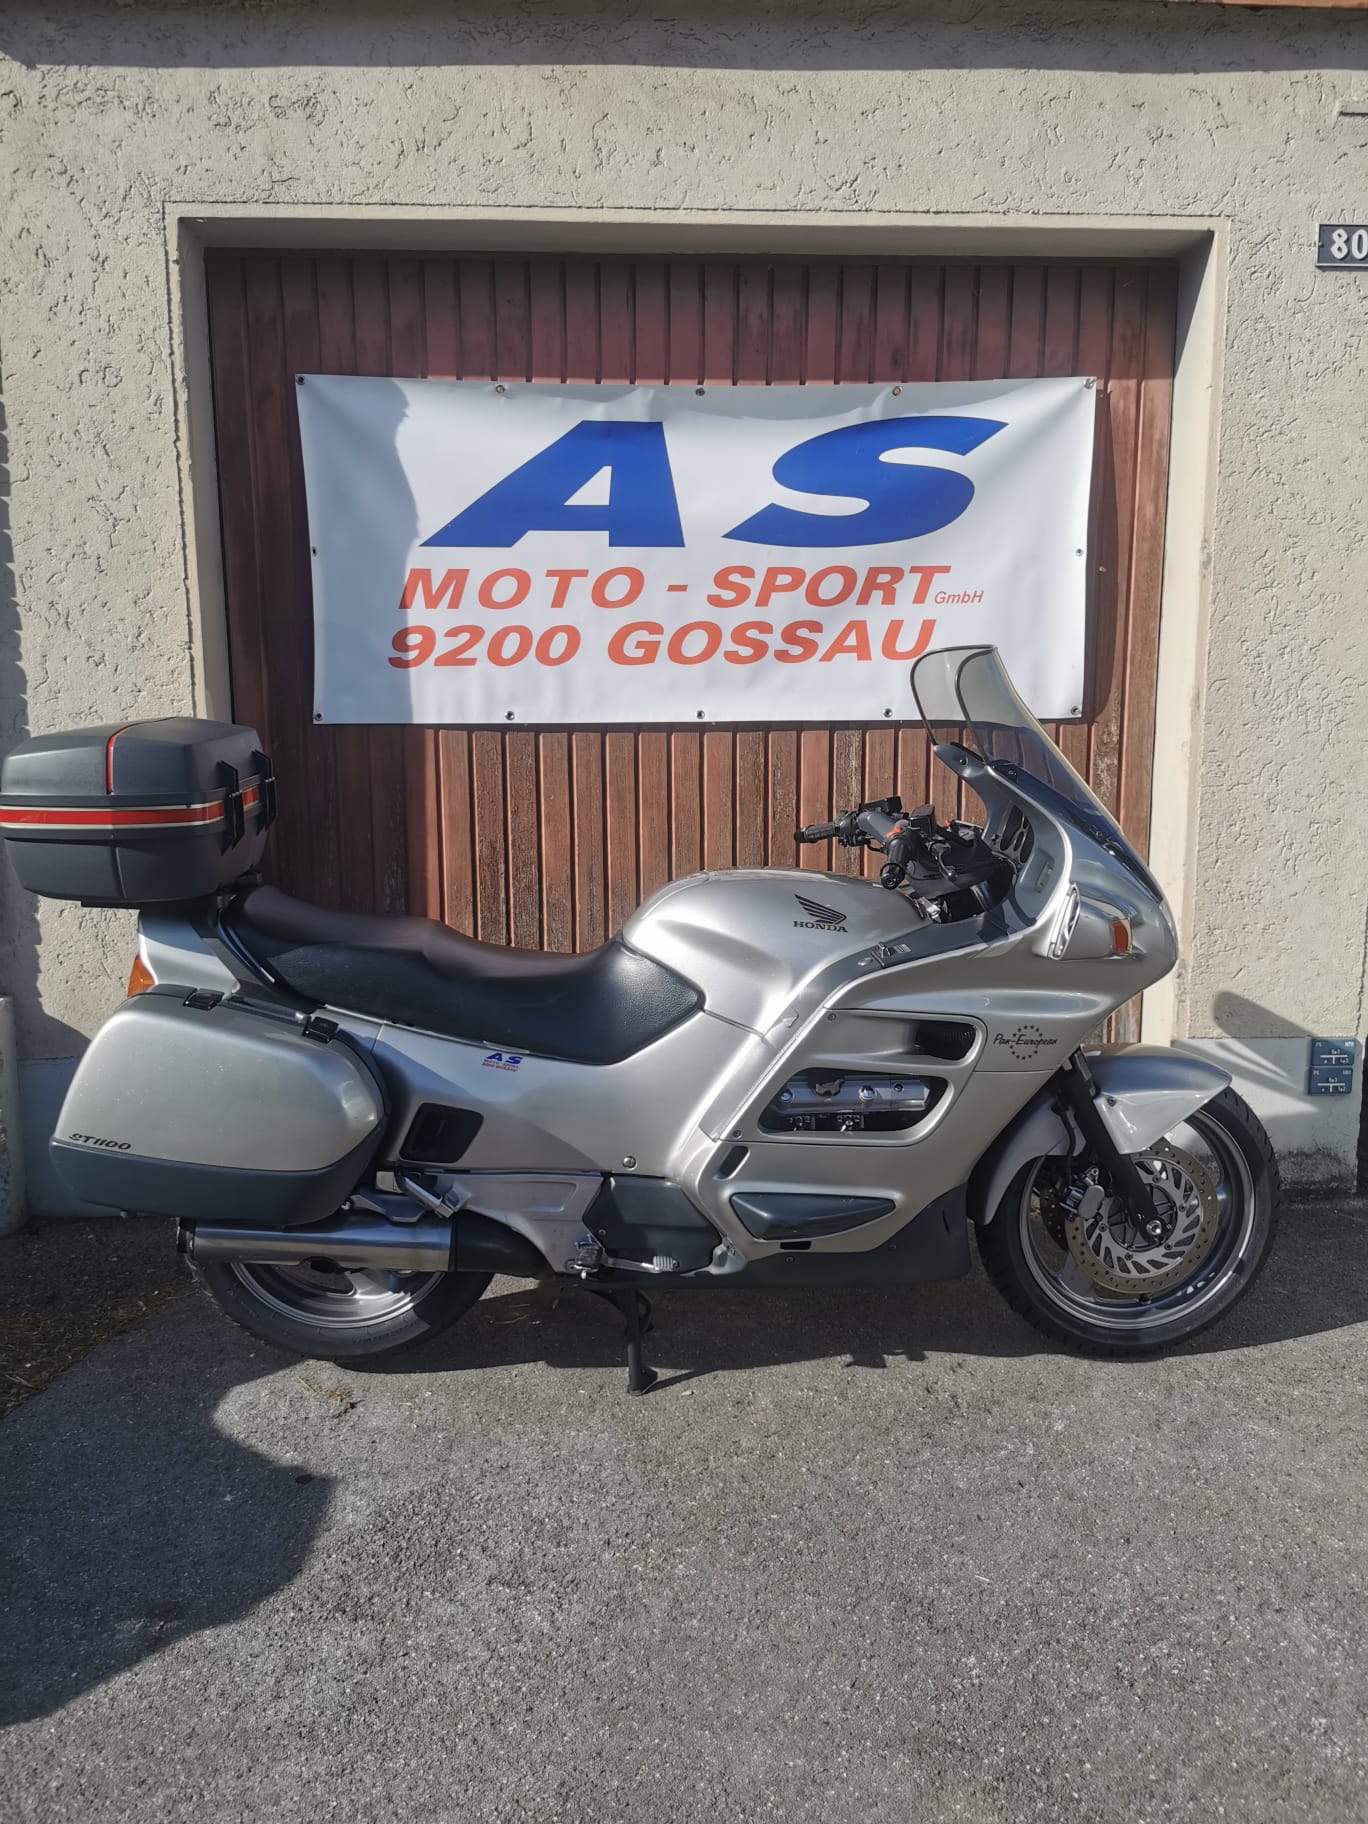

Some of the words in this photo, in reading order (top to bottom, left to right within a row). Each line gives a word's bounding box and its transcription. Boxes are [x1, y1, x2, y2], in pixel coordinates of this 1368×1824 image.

[1330, 228, 1368, 260] 80
[398, 567, 645, 610] MOTO
[706, 565, 952, 608] SPORT
[934, 590, 985, 604] GmbH
[388, 624, 581, 669] 9200
[607, 619, 937, 666] GOSSAU
[793, 921, 848, 933] HONDA
[993, 1033, 1058, 1048] Pan-European
[69, 1133, 131, 1150] ST1100
